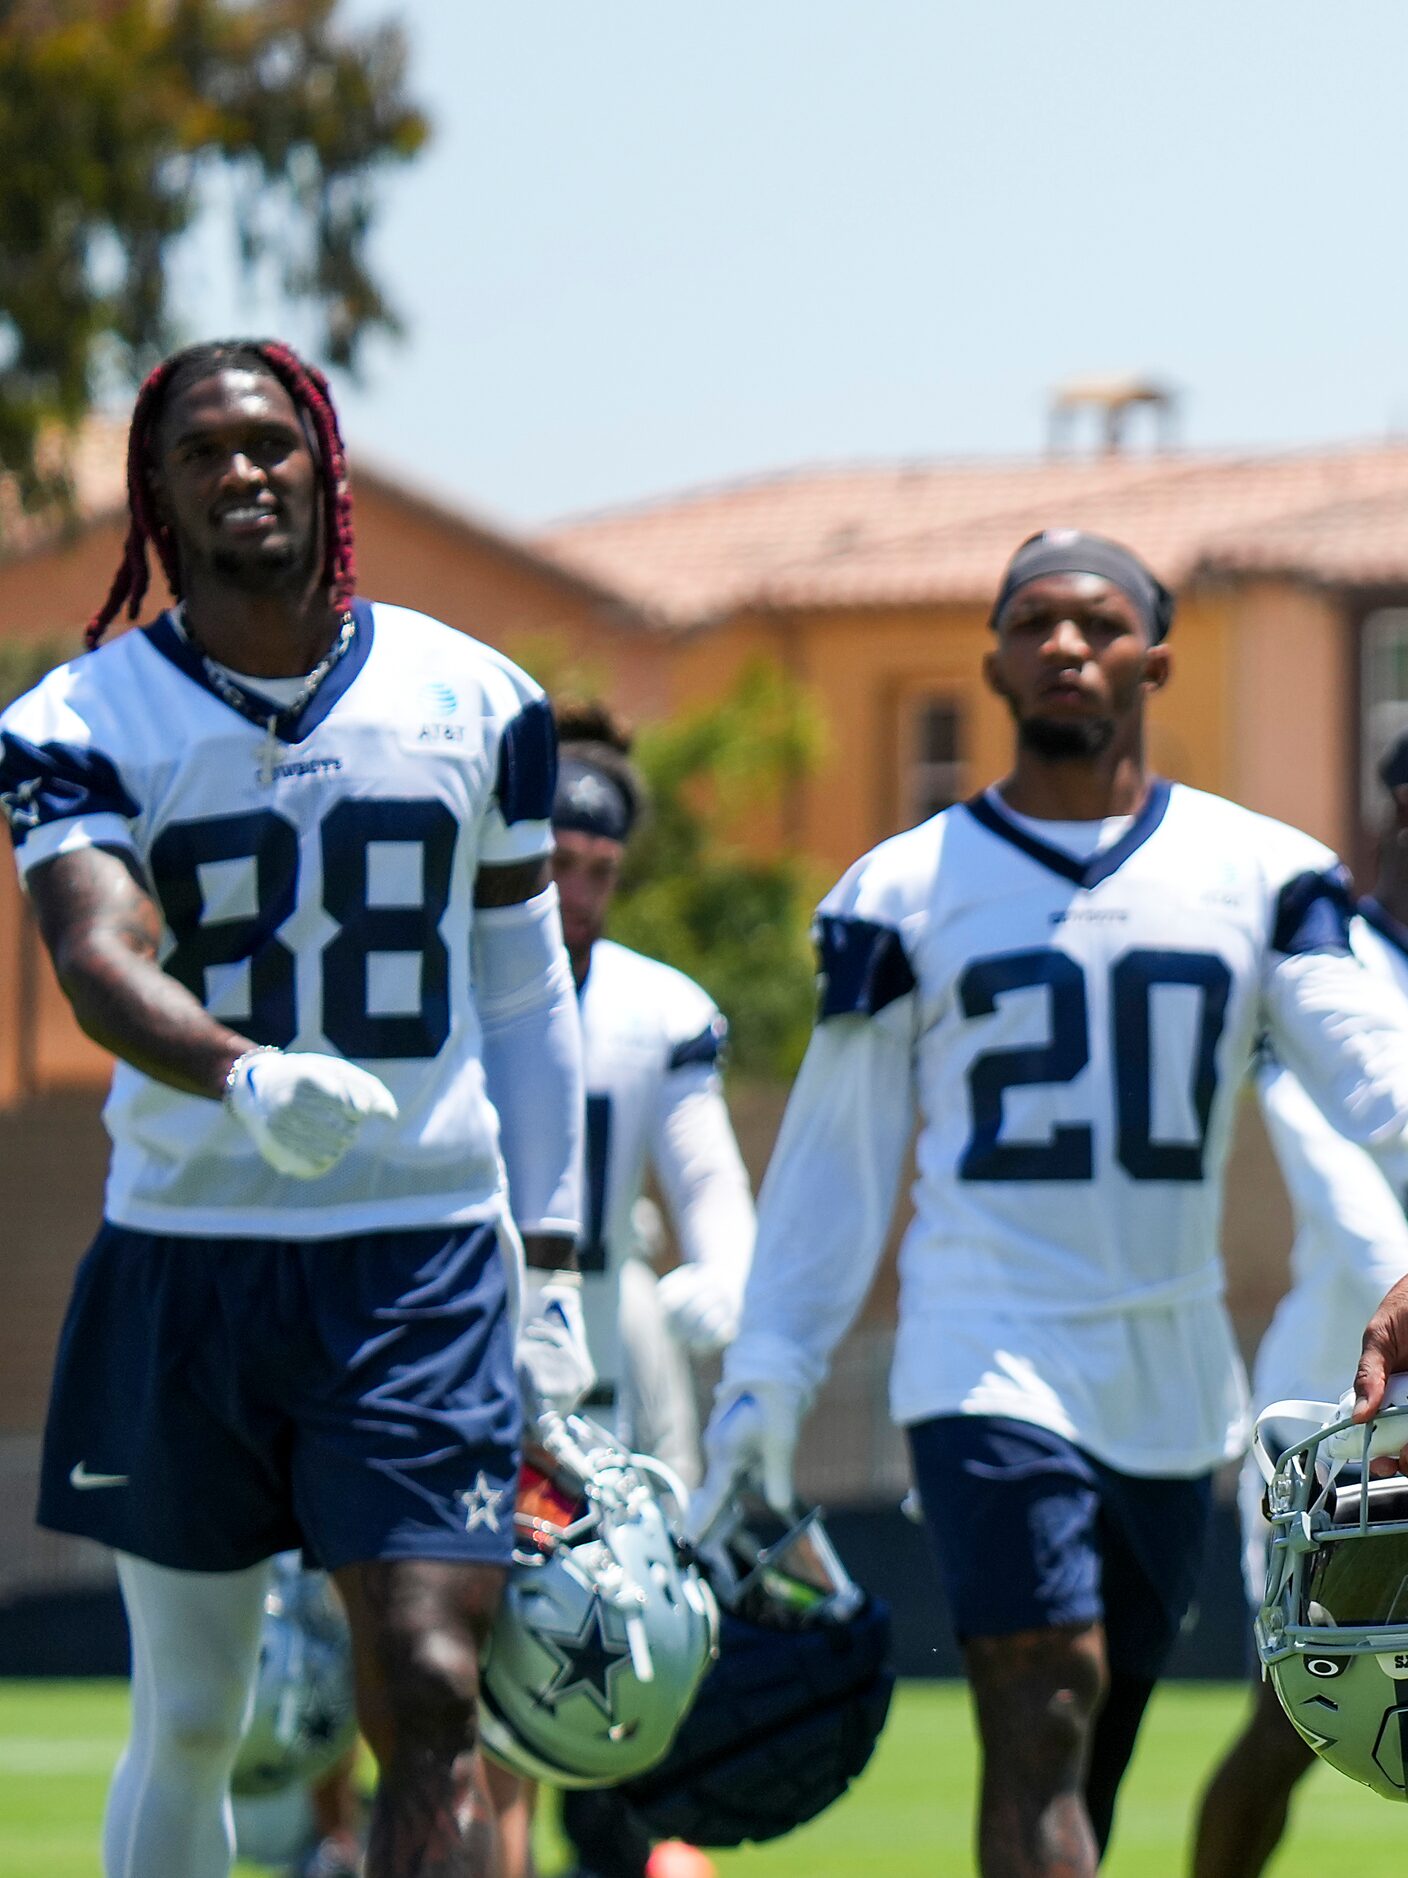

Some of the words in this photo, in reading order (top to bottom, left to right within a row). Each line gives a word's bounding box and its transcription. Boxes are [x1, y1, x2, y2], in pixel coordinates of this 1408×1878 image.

[418, 723, 467, 742] AT&T
[150, 797, 459, 1059] 88
[957, 945, 1232, 1180] 20
